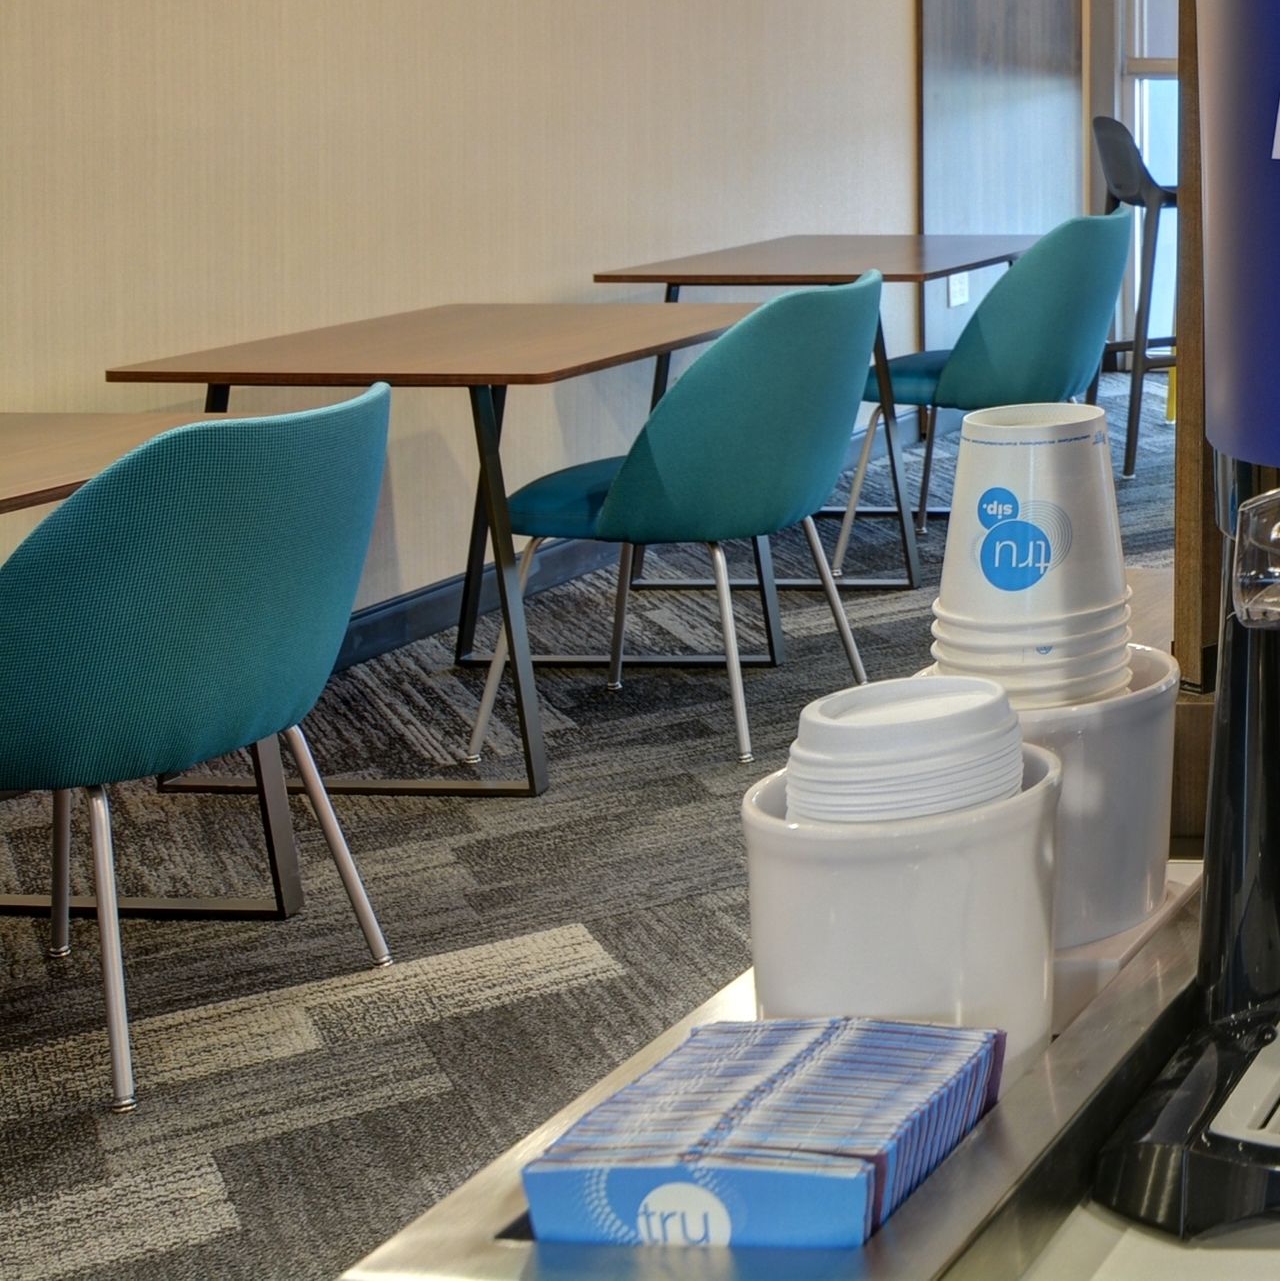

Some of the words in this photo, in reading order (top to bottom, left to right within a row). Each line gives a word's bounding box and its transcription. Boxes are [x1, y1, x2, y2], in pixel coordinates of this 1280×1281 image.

[983, 500, 1013, 519] sip.
[994, 540, 1051, 575] tru
[638, 1202, 710, 1246] tru
